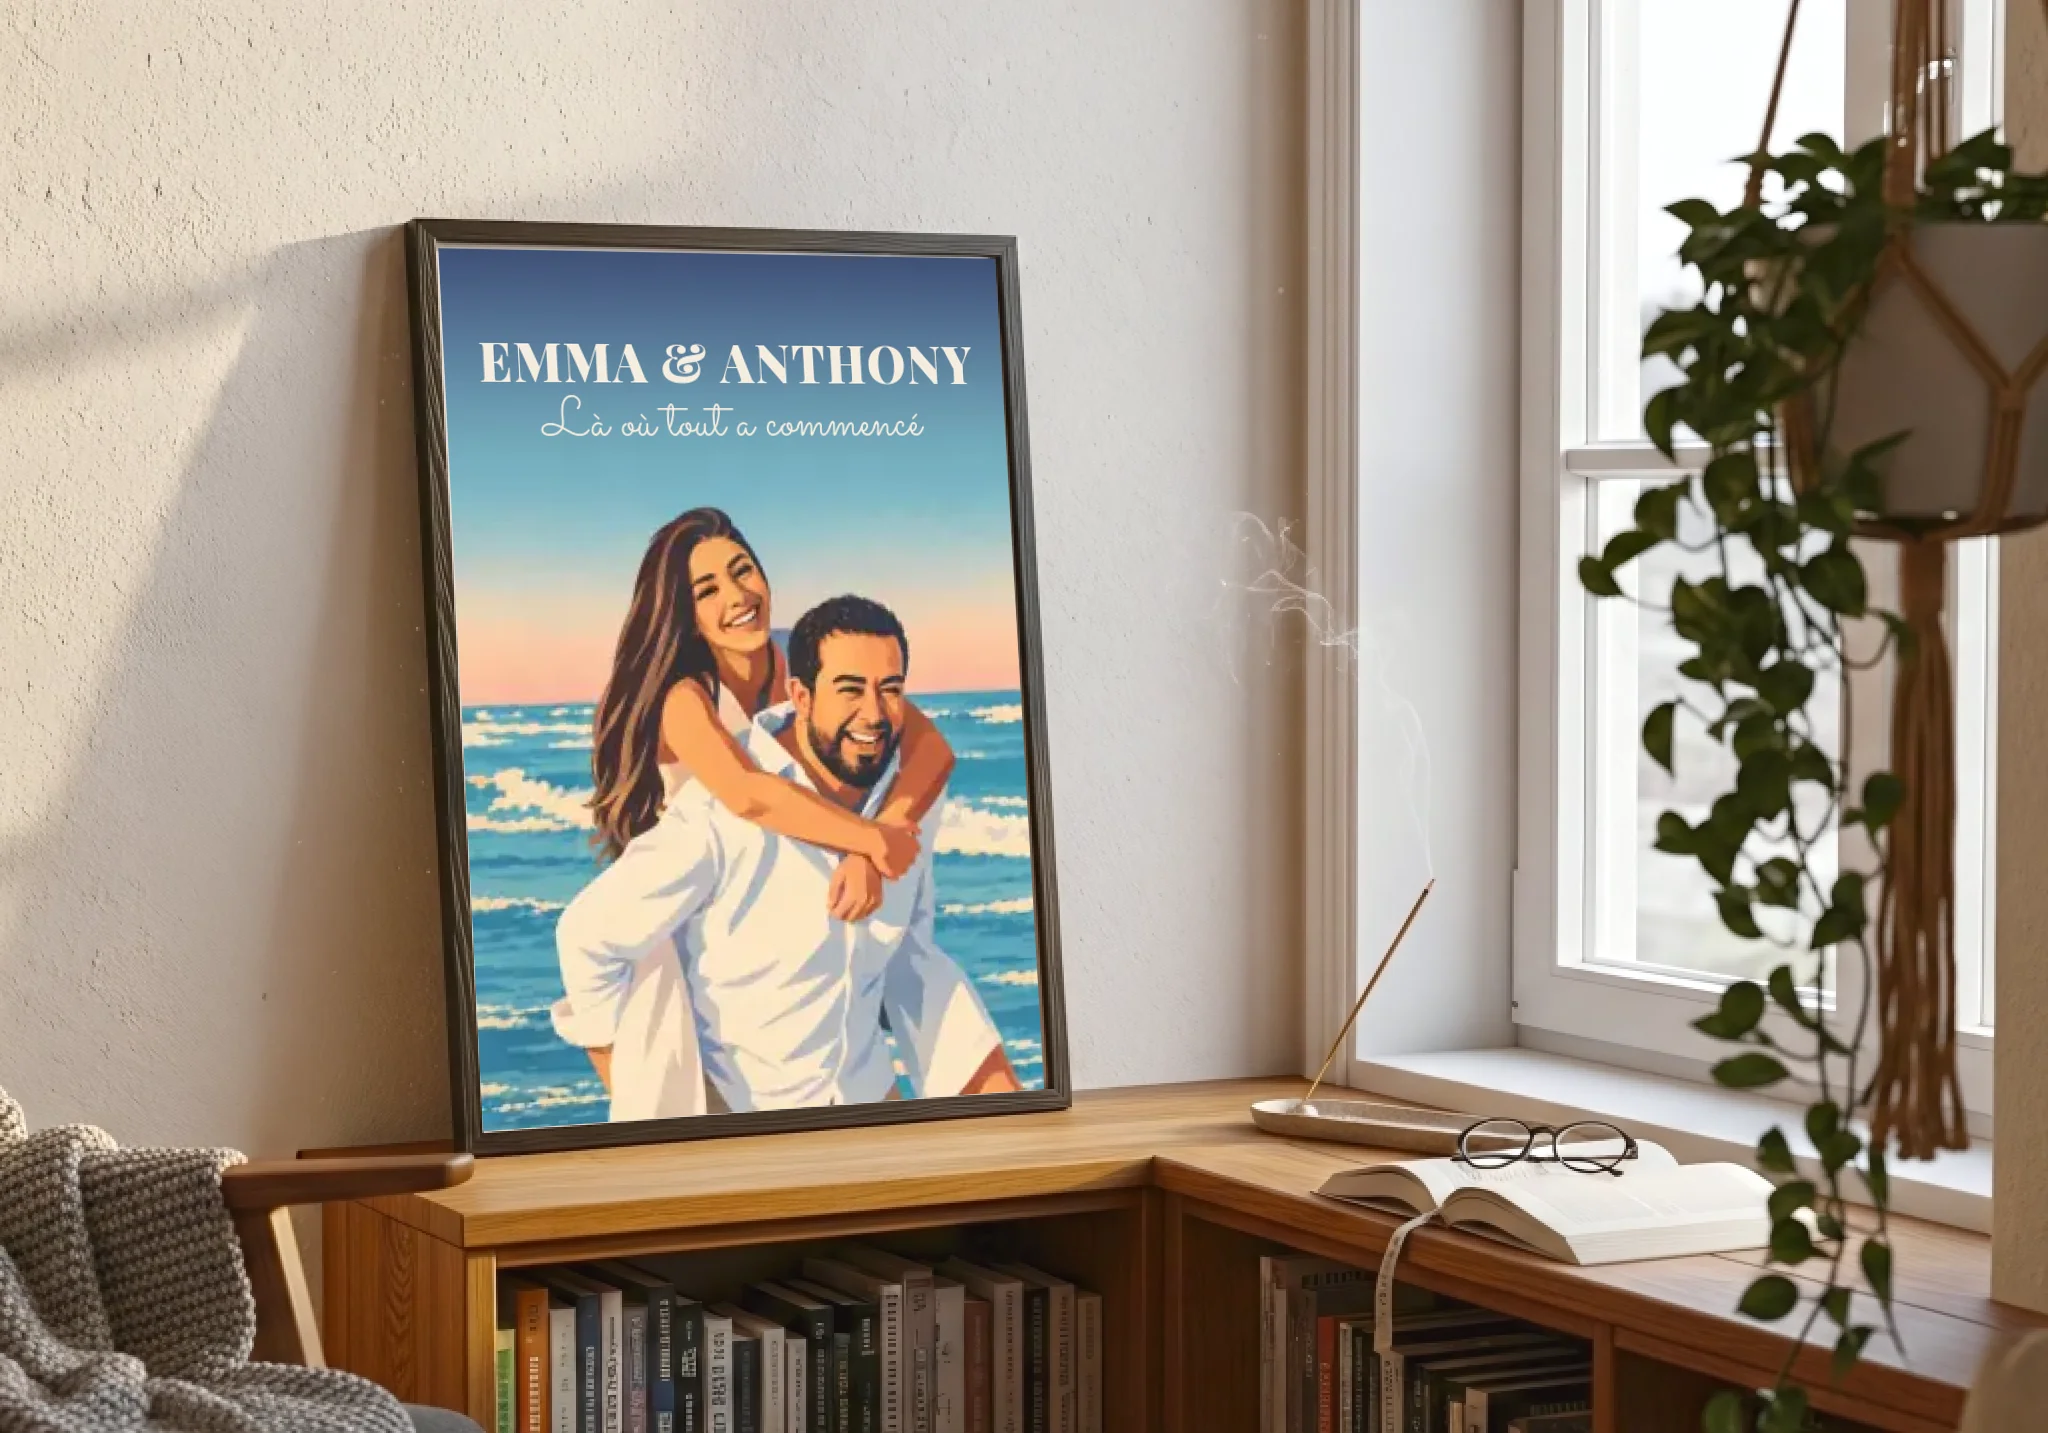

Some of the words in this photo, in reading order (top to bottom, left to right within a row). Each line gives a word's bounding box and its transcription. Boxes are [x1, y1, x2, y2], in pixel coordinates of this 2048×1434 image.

[478, 342, 649, 384] EMMA
[661, 343, 706, 384] &
[719, 344, 971, 385] ANTHONY
[540, 394, 613, 437] Là
[621, 413, 659, 437] où
[656, 402, 734, 437] tout
[736, 421, 757, 437] a
[766, 412, 925, 437] commencé
